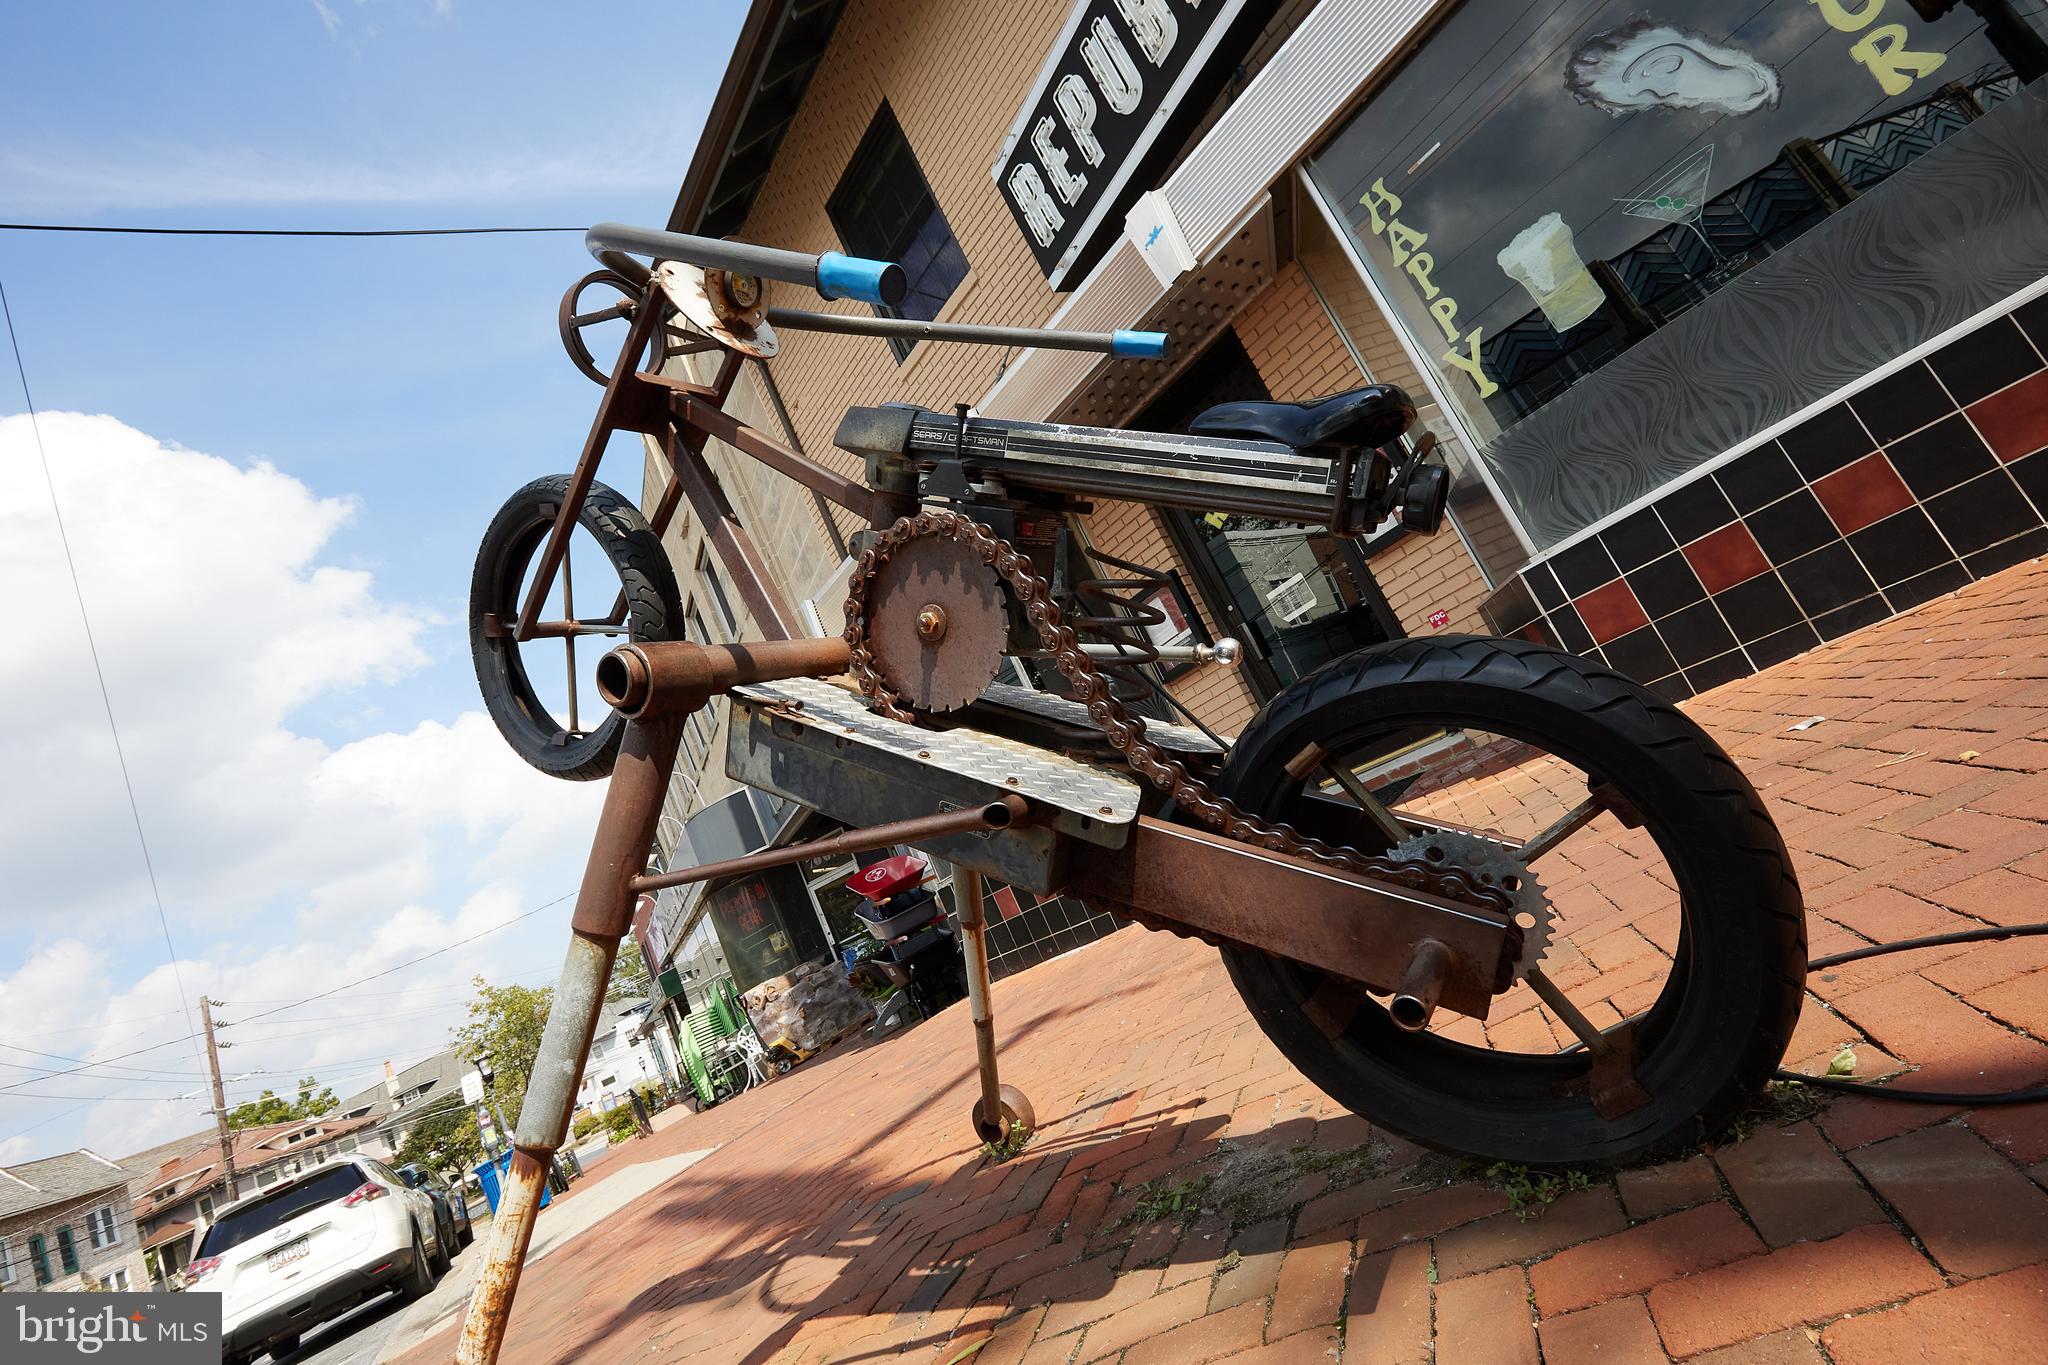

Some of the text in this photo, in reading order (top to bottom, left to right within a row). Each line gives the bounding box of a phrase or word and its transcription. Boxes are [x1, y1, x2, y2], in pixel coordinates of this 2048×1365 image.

[1007, 0, 1201, 248] REPUB
[1359, 176, 1499, 399] HAPPY
[1429, 611, 1446, 623] FDC
